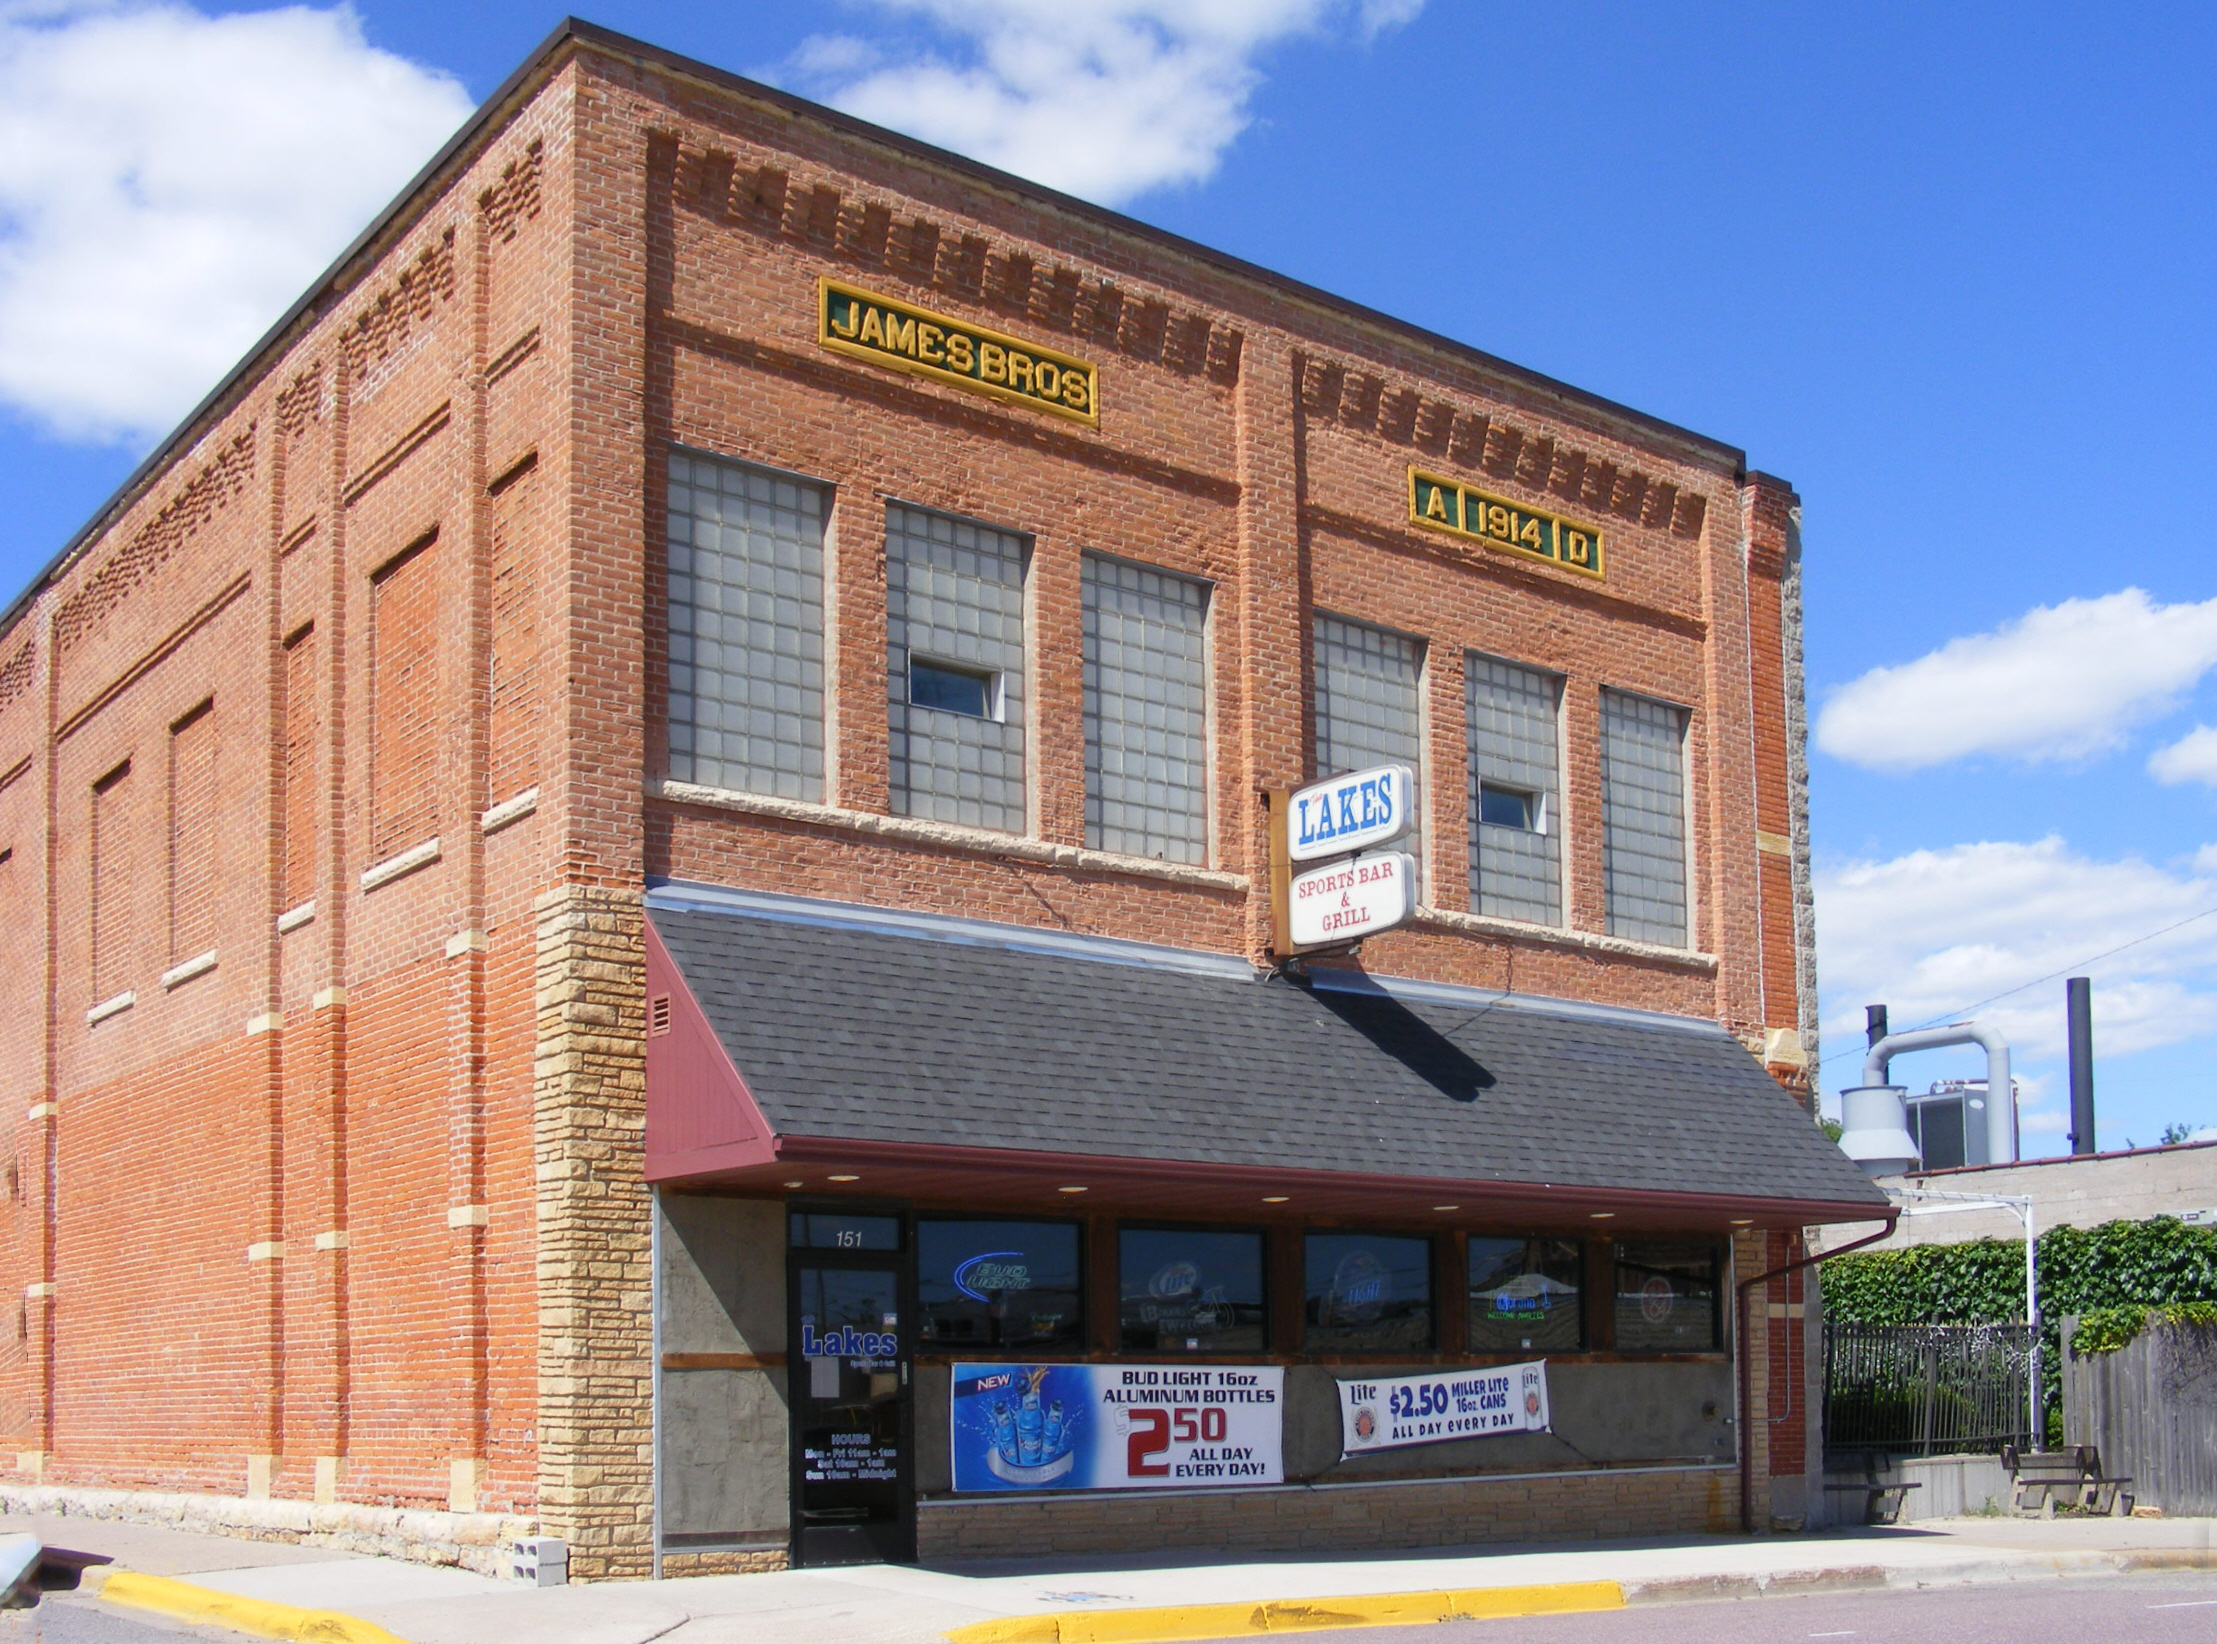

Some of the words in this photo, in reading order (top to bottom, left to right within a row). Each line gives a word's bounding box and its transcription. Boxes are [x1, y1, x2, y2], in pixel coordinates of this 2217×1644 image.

[831, 301, 974, 373] JAMES
[979, 341, 1088, 407] BROS
[1426, 486, 1447, 520] A
[1478, 501, 1542, 550] 1914
[1569, 530, 1588, 564] D
[1298, 773, 1392, 845] LAKES
[1299, 870, 1355, 899] SPORTS
[1359, 862, 1394, 884] BAR
[1341, 891, 1350, 907] &
[1322, 907, 1371, 932] GRILL
[836, 1231, 862, 1247] 151
[802, 1324, 898, 1357] Lakes
[977, 1374, 1011, 1391] NEW
[1122, 1371, 1158, 1386] BUD
[1163, 1371, 1212, 1386] LIGHT
[1218, 1372, 1258, 1386] 16oz
[1103, 1389, 1199, 1403] ALUMINUM
[1203, 1389, 1276, 1403] BOTTLES
[1350, 1384, 1376, 1405] Lite
[1451, 1379, 1486, 1398] MILLER
[1389, 1383, 1449, 1423] $2.50
[1480, 1393, 1507, 1410] CANS
[1392, 1424, 1414, 1440] ALL
[1419, 1421, 1442, 1436] DAY
[1492, 1412, 1514, 1427] DAY
[831, 1433, 871, 1445] HOURS
[805, 1448, 825, 1459] Mon
[1189, 1448, 1218, 1461] ALL
[1221, 1447, 1254, 1460] DAY
[805, 1469, 825, 1480] Sun
[1175, 1463, 1226, 1477] EVERY
[1229, 1462, 1265, 1475] DAY!
